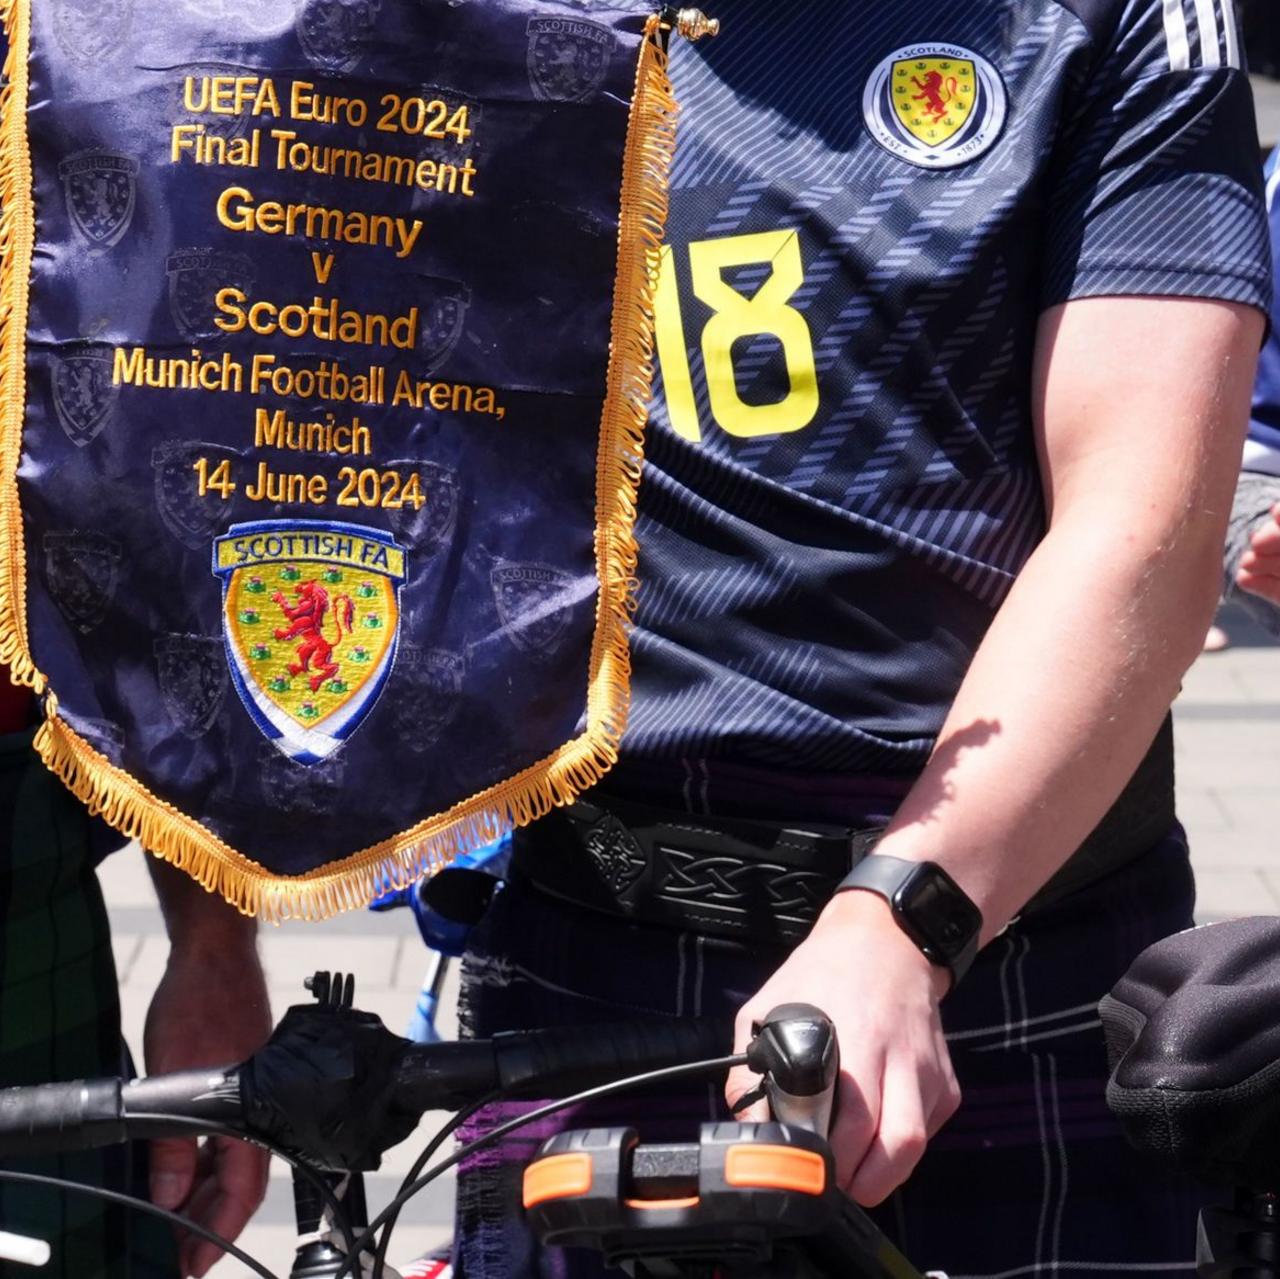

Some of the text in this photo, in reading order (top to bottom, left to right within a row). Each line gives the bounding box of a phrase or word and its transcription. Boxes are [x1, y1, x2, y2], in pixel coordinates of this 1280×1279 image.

[536, 19, 592, 39] SCOTTISH
[903, 45, 963, 58] SCOTLAND
[184, 76, 472, 144] UEFA Euro 2024
[171, 126, 477, 198] Final Tournament
[882, 135, 902, 152] EST
[961, 136, 983, 155] 1873
[217, 187, 424, 259] Germany
[311, 251, 334, 286] v
[214, 288, 418, 350] Scotland
[647, 228, 819, 443] 18
[112, 347, 506, 418] Munich Football Arena,
[254, 407, 372, 456] Munich
[194, 458, 237, 503] 14
[246, 461, 328, 506] June
[337, 467, 426, 511] 2024
[233, 533, 390, 569] SCOTTISH FA
